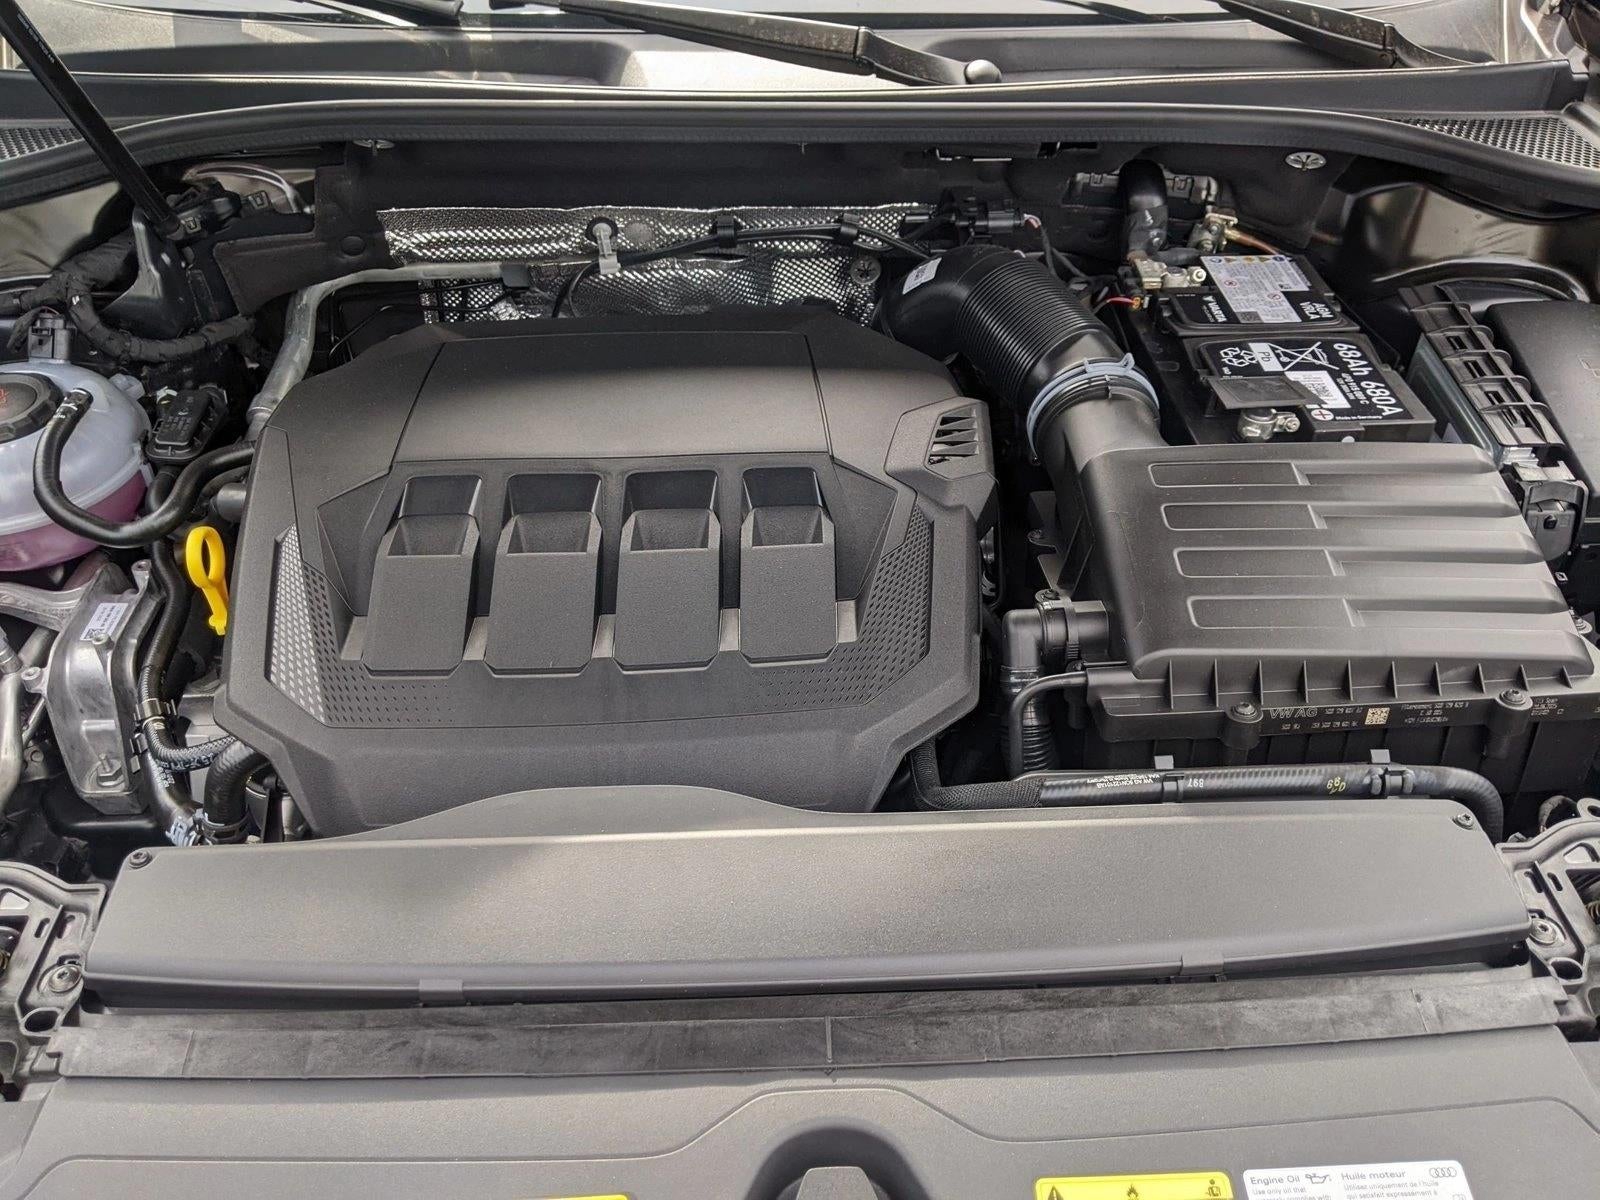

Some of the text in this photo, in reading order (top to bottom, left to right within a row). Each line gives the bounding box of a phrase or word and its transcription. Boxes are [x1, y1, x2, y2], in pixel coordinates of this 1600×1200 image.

[1208, 302, 1227, 322] VARTA
[1300, 301, 1320, 320] VRLA
[1312, 302, 1334, 318] AGM
[1258, 351, 1271, 362] Pb
[1333, 343, 1404, 416] 68Ah 680A
[1269, 708, 1295, 719] VW
[1295, 707, 1318, 718] AG
[1187, 778, 1204, 788] 897
[1250, 1175, 1300, 1186] Engine Oil
[1341, 1171, 1406, 1181] Huile moteur
